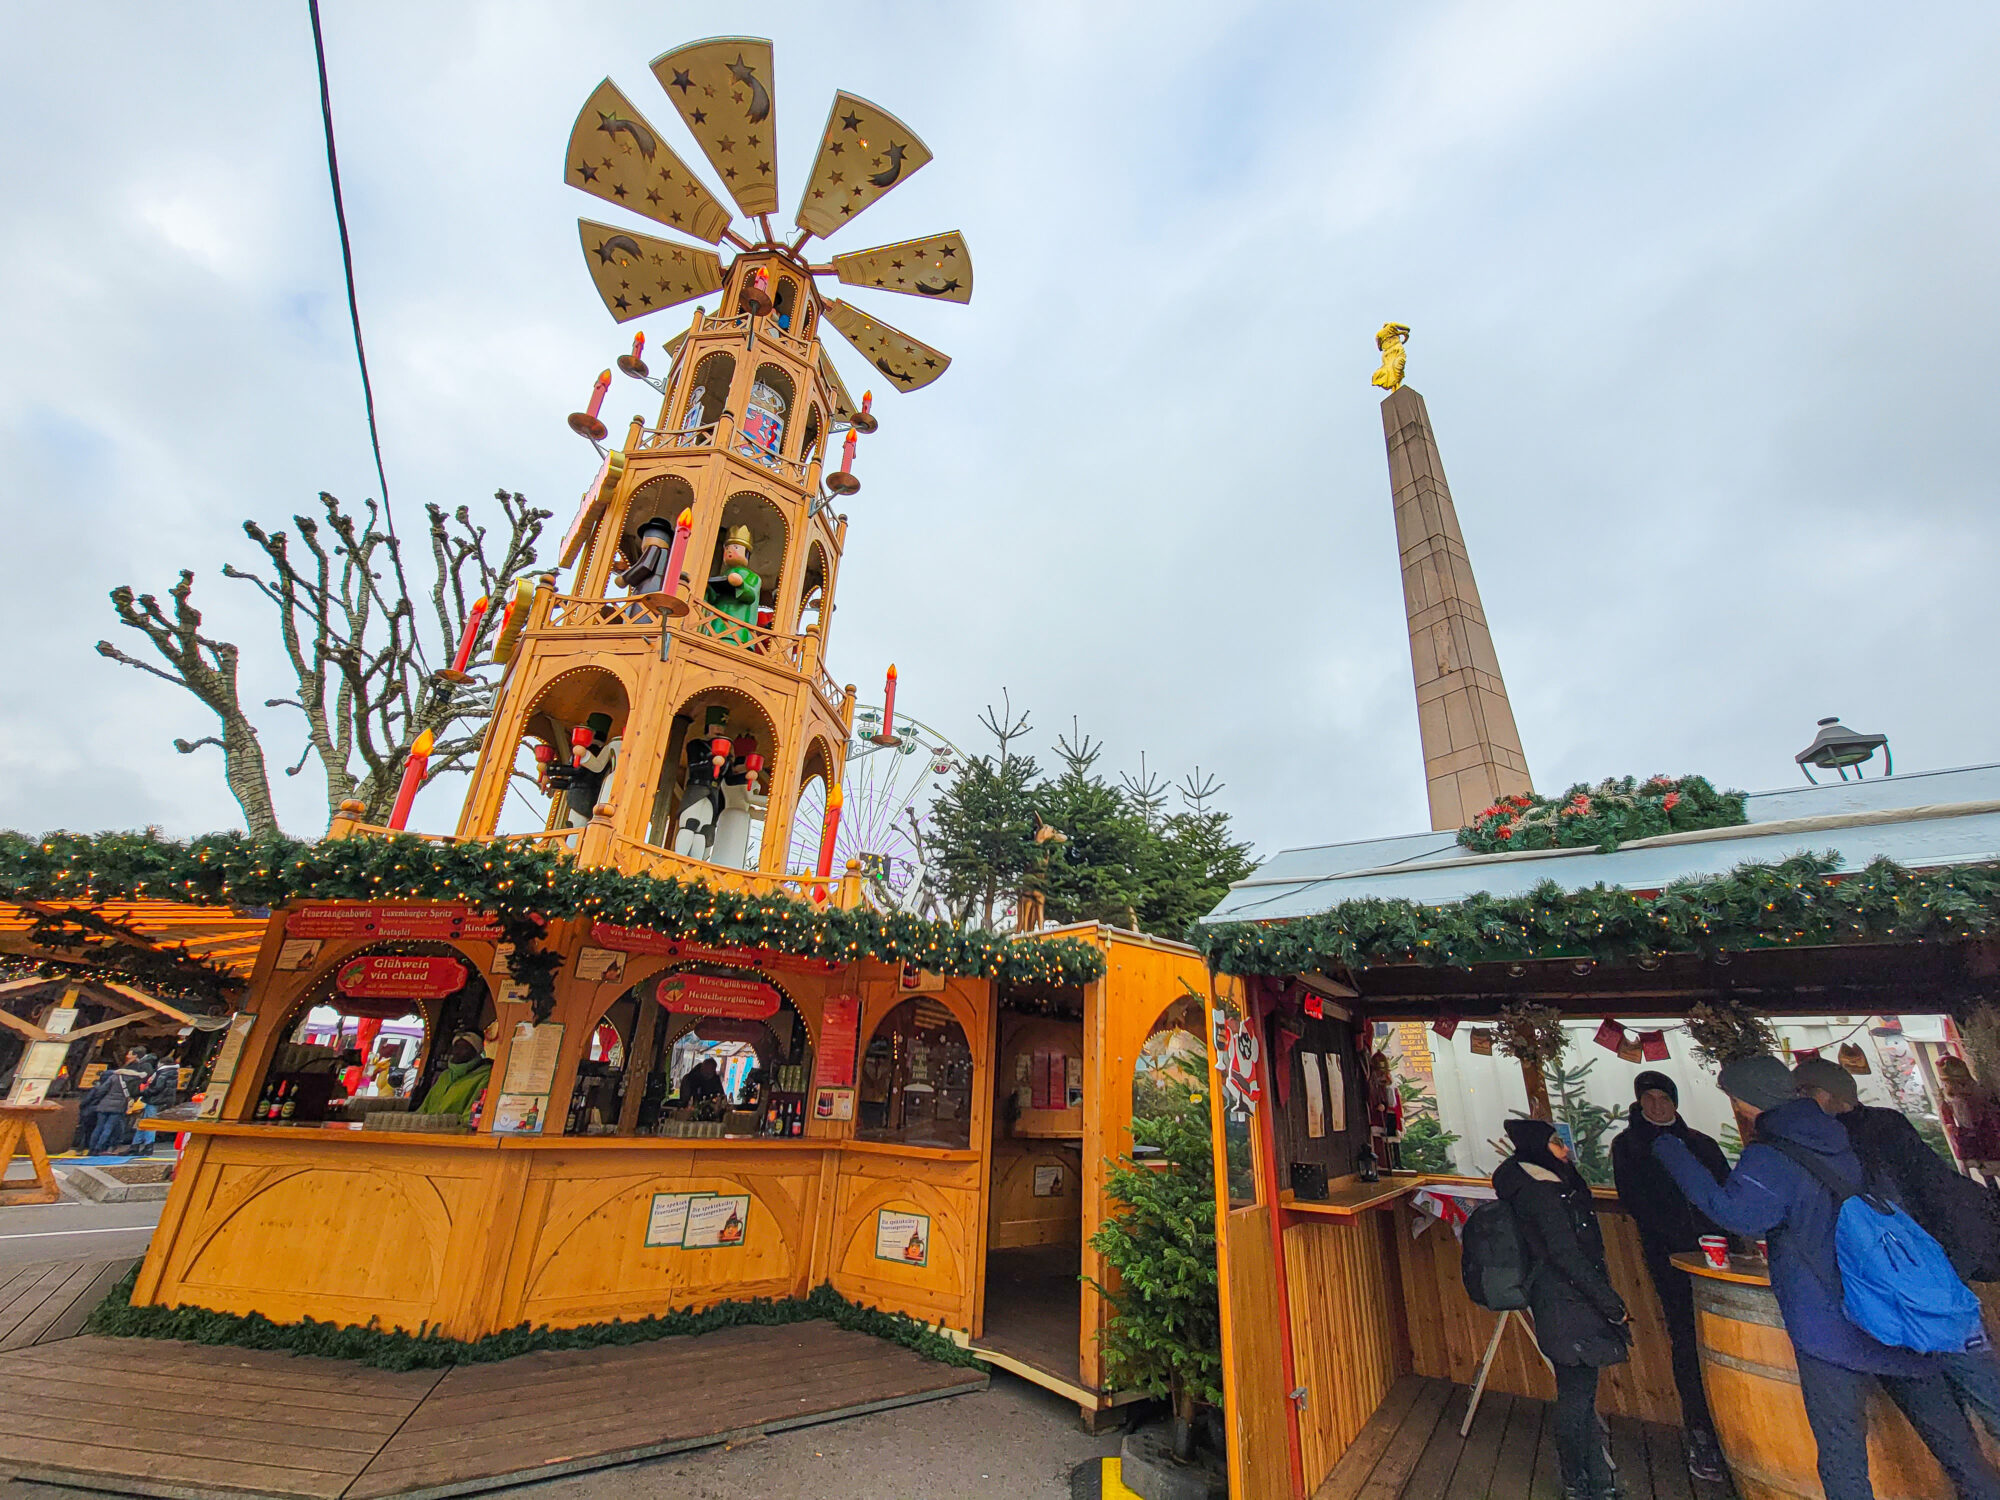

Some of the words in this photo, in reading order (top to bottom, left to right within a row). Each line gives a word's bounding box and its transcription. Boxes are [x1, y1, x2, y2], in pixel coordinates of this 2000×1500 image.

[302, 907, 372, 919] Feuerzangenbowle
[381, 908, 427, 918] Luxemburger
[430, 909, 453, 918] Spritz
[378, 927, 410, 936] Bratapfel
[610, 929, 624, 937] vin
[626, 930, 652, 940] chaud
[374, 958, 430, 969] Glühwein
[371, 971, 387, 980] vin
[392, 970, 429, 980] chaud
[699, 976, 759, 991] Kirschglühwein
[688, 990, 766, 1006] Heidelbeerglühwein
[683, 1003, 722, 1015] Bratapfel
